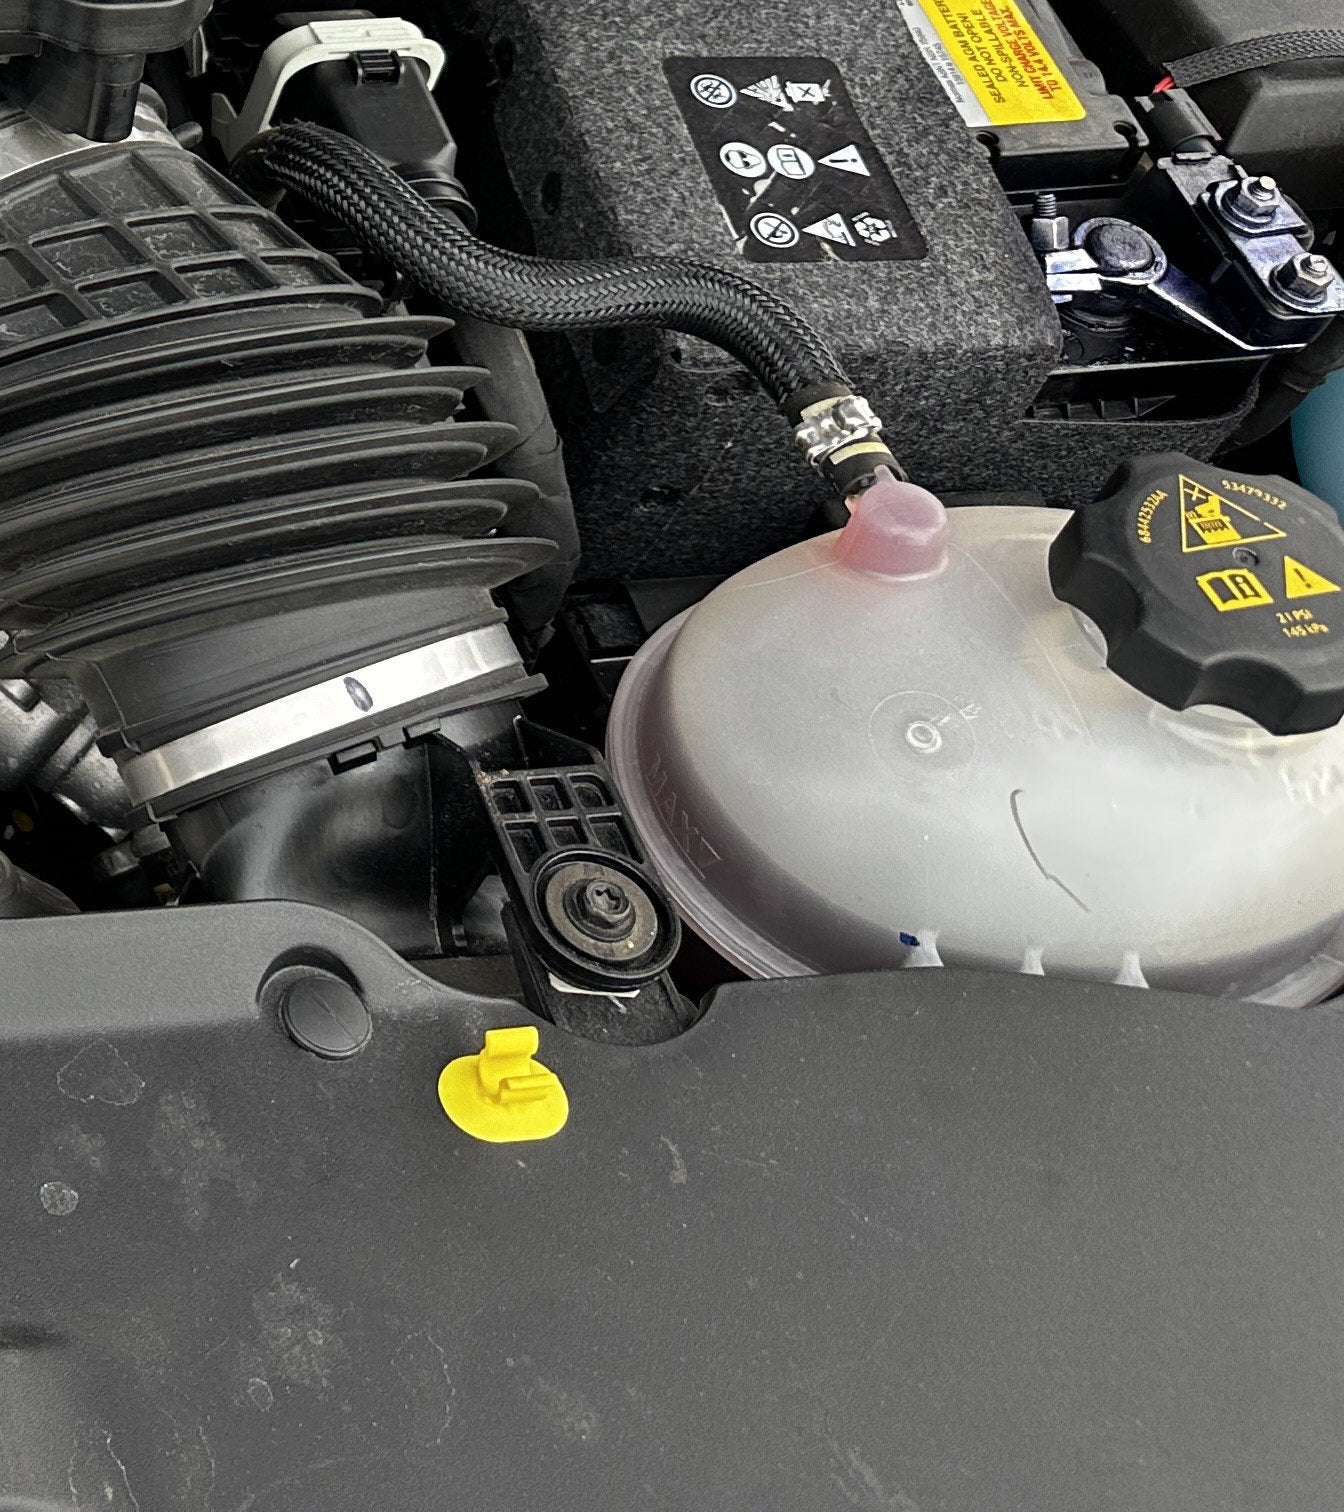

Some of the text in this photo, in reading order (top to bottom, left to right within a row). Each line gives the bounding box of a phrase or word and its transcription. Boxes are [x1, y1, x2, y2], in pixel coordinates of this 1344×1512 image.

[979, 0, 1013, 36] VOLTAGE
[956, 40, 979, 61] AGM
[969, 8, 1029, 87] NON-SPILLABLE
[975, 45, 997, 65] NOT
[1006, 39, 1037, 73] CHARGE
[971, 64, 1006, 103] SEALED
[989, 67, 1007, 81] DO
